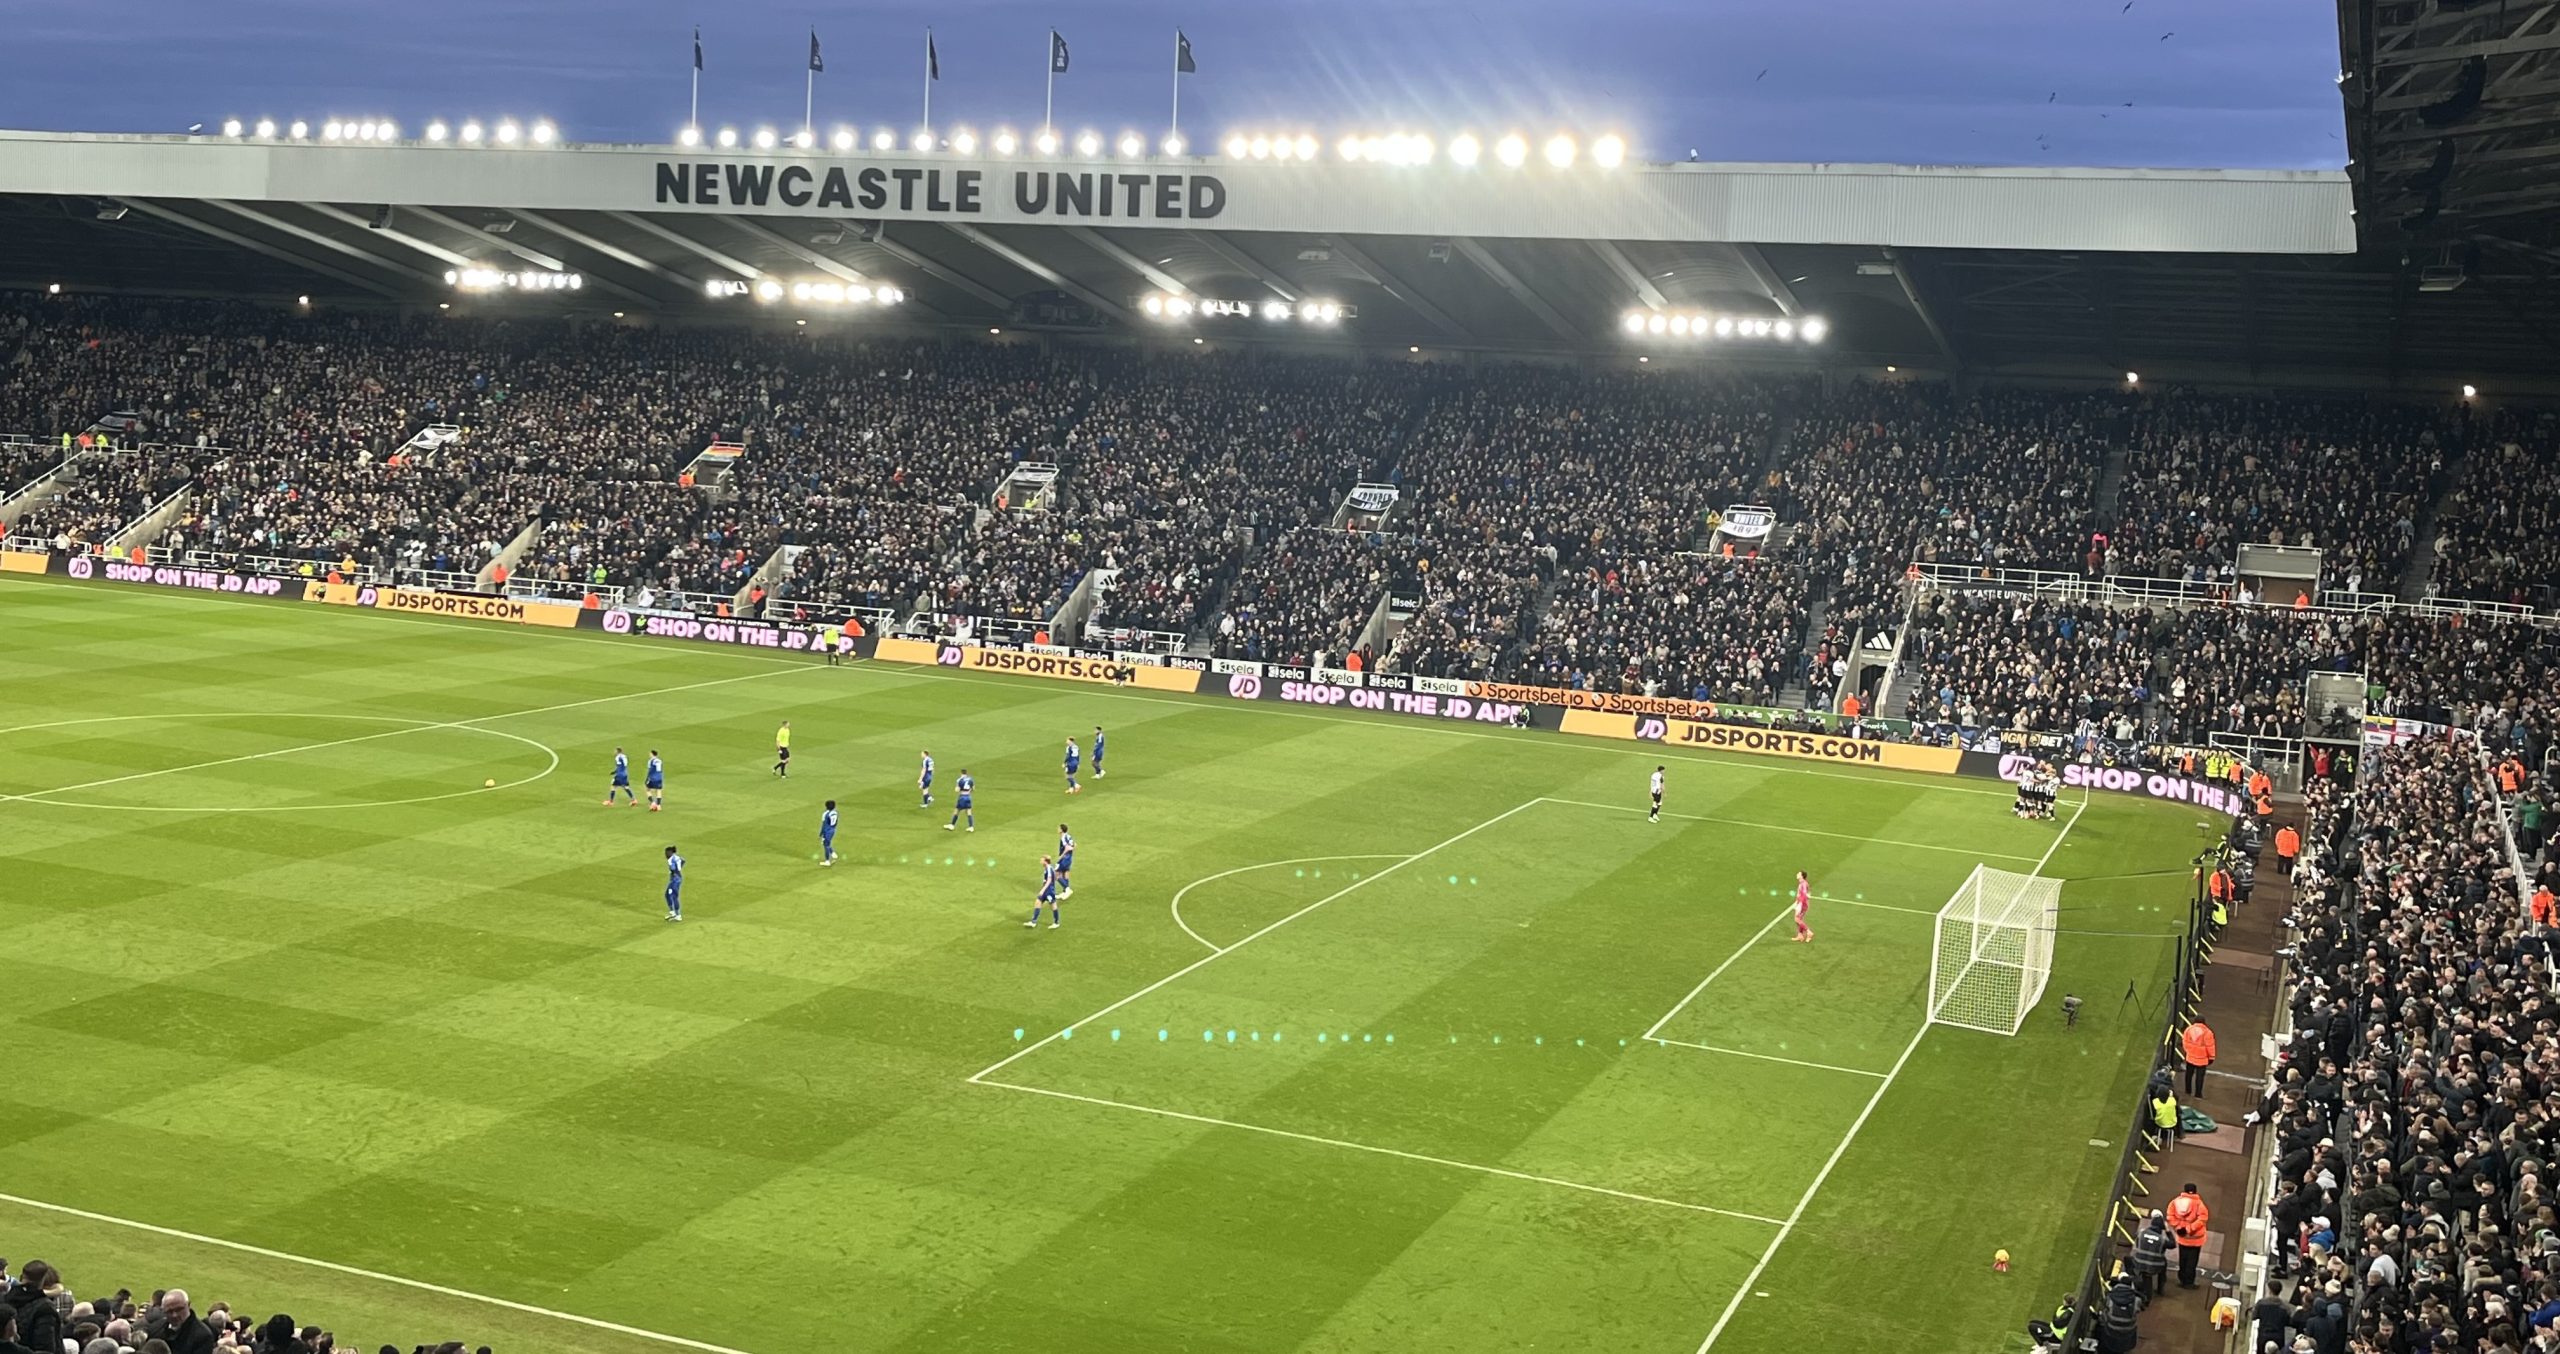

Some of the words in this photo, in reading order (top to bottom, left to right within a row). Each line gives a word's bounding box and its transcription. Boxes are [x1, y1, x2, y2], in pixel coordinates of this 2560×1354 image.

[656, 162, 981, 213] NEWCASTLE
[1015, 171, 1227, 219] UNITED
[105, 563, 152, 583] SHOP
[155, 568, 180, 587] ON
[183, 570, 217, 589] THE
[219, 574, 243, 591] JD
[244, 577, 281, 595] APP
[357, 588, 376, 605] JD
[387, 593, 524, 619] JDSPORTS.COM
[646, 619, 701, 639] SHOP
[704, 624, 735, 643] ON
[738, 626, 779, 647] THE
[781, 631, 809, 650] JD
[810, 634, 854, 654] AP
[938, 646, 962, 664] JD
[1181, 658, 1206, 671] sela
[1231, 664, 1255, 675] sela
[1279, 668, 1305, 680] sela
[1380, 676, 1407, 690] sela
[1432, 680, 1458, 693] sela
[1280, 681, 1345, 705] SHOP
[1349, 689, 1385, 710] ON
[1389, 693, 1437, 716] THE
[1442, 698, 1472, 719] JD
[1487, 683, 1584, 706] Sportsbet.io
[1610, 694, 1711, 718] Sportsbet.io
[1637, 719, 1667, 739] JD
[1681, 724, 1881, 762] JDSPORTS.COM
[2040, 735, 2063, 748] BET
[2063, 763, 2142, 791] SHOP
[2146, 775, 2188, 800] ON
[2190, 781, 2225, 811] THE
